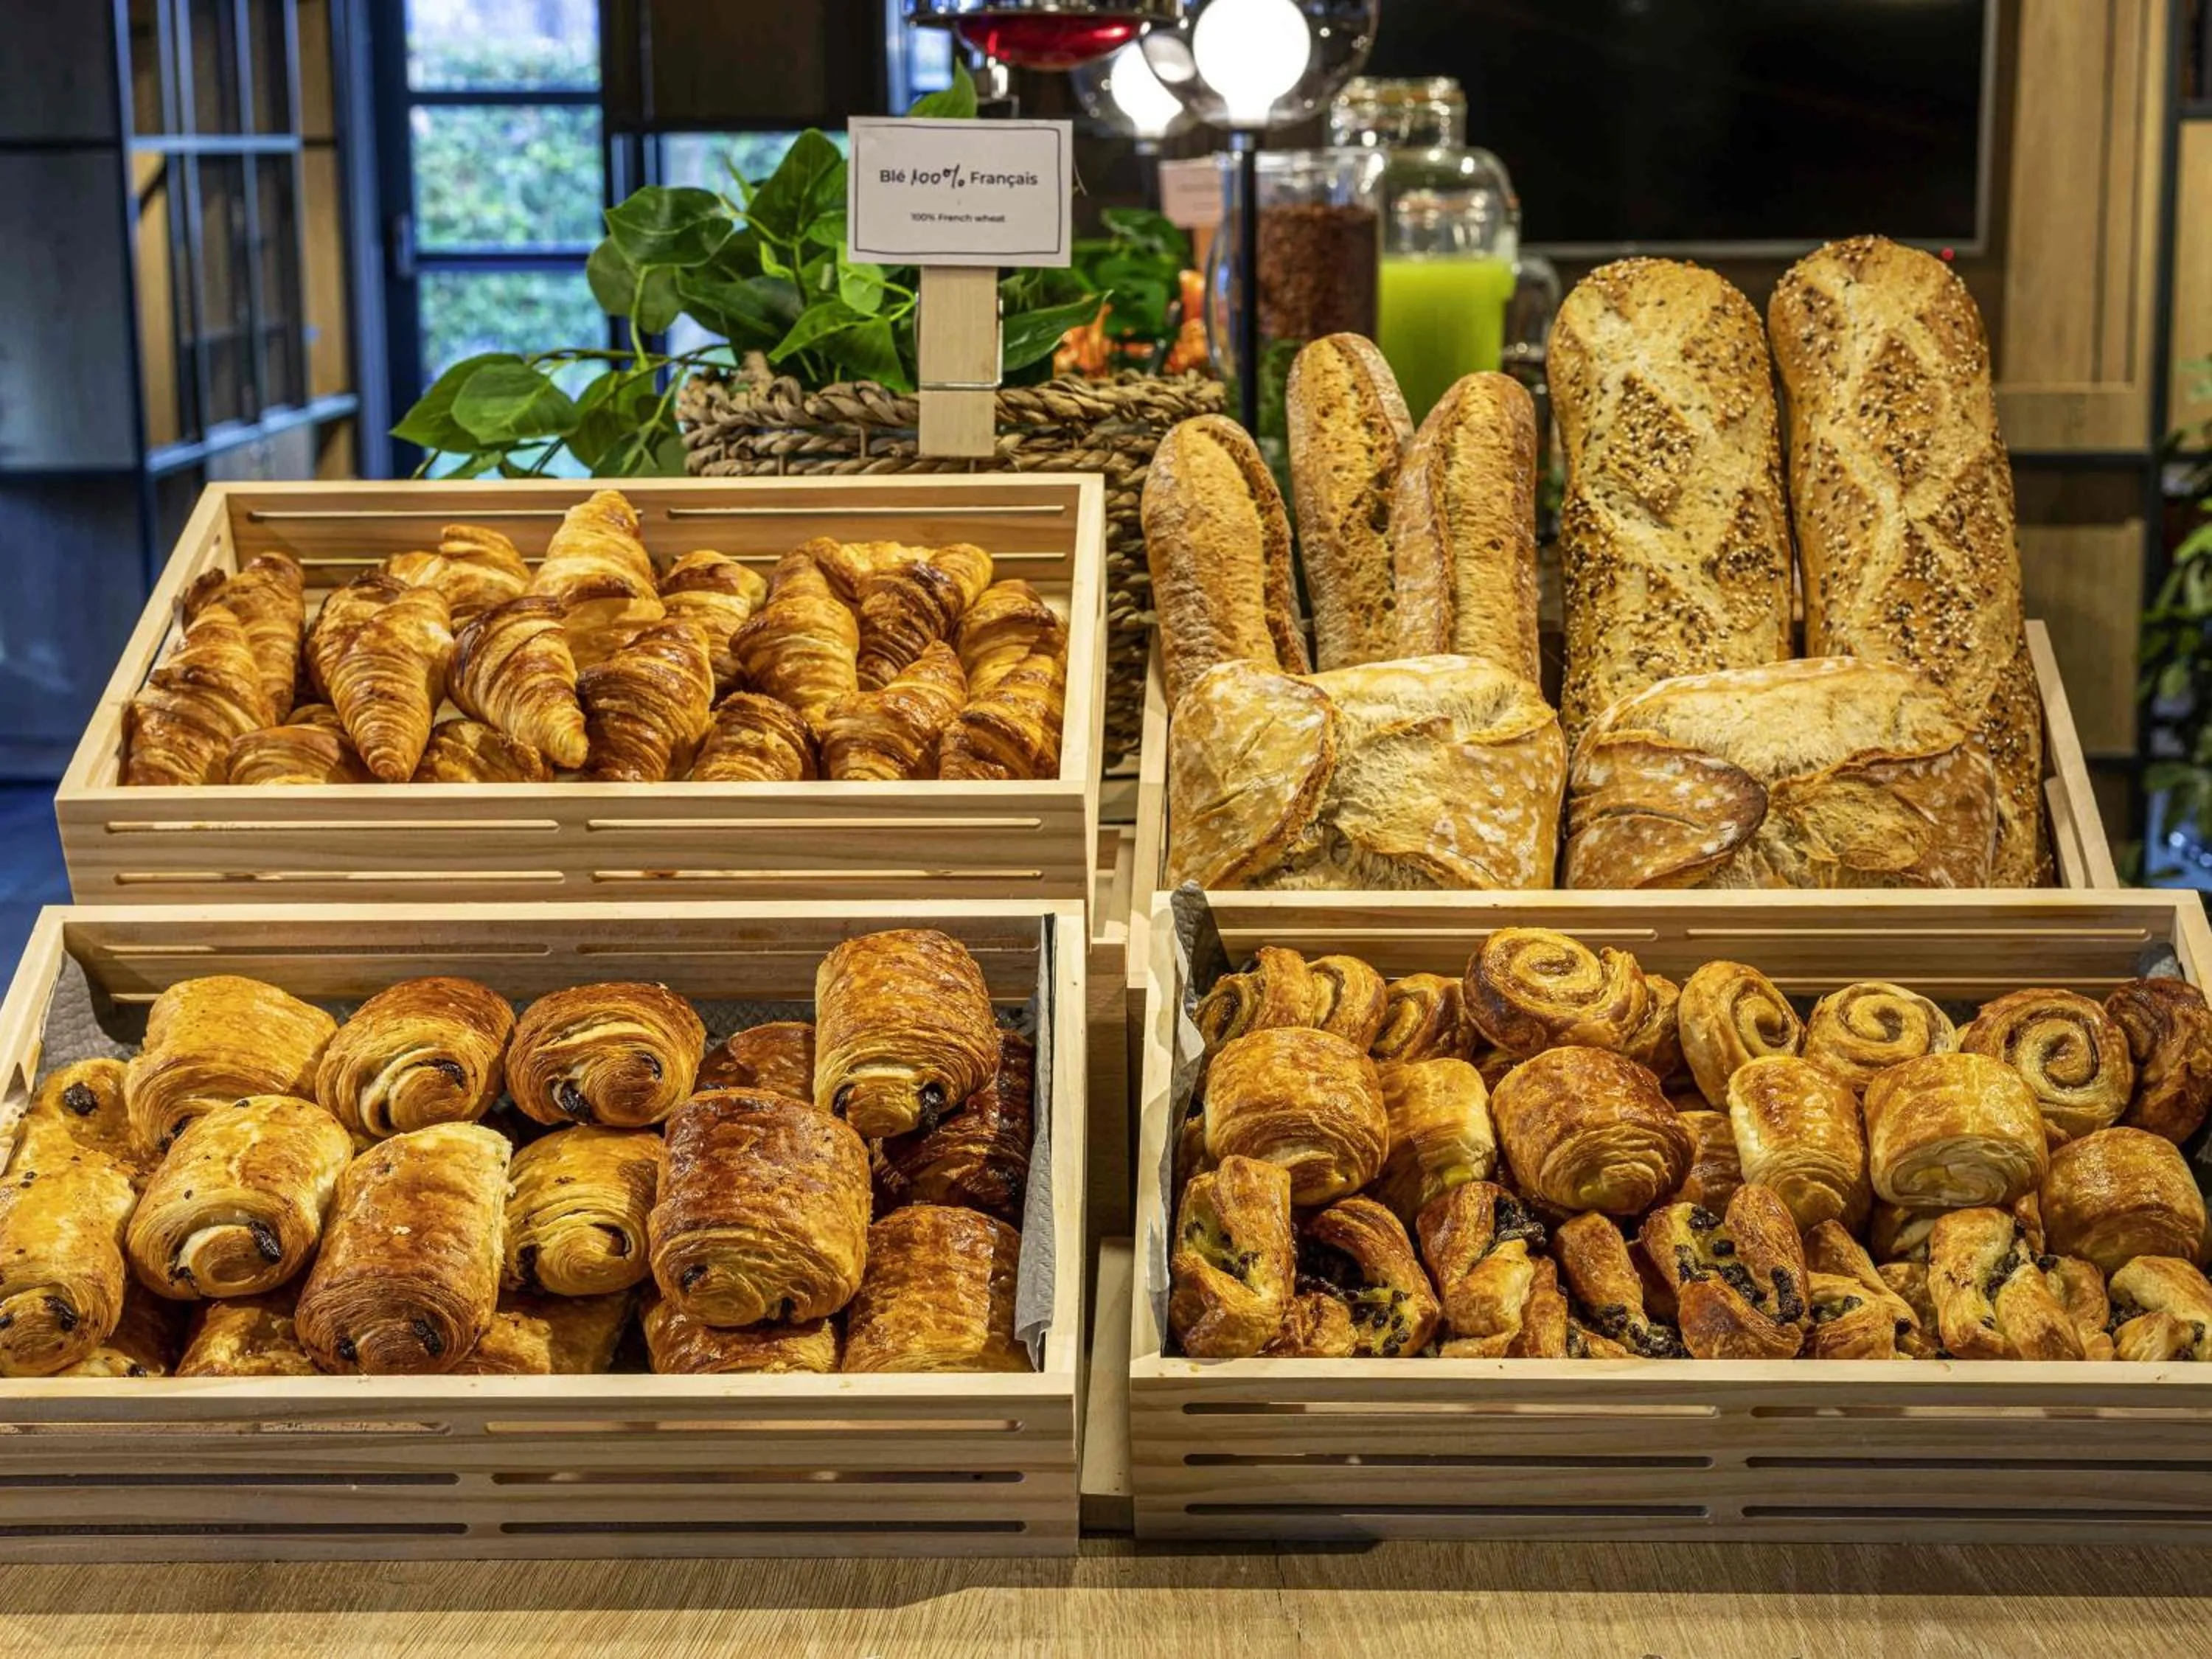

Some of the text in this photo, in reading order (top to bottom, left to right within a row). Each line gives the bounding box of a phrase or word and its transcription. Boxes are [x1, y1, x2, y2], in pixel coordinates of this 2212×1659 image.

[880, 164, 1038, 188] Blé 100% Français
[911, 212, 1005, 223] 100% French wheat
